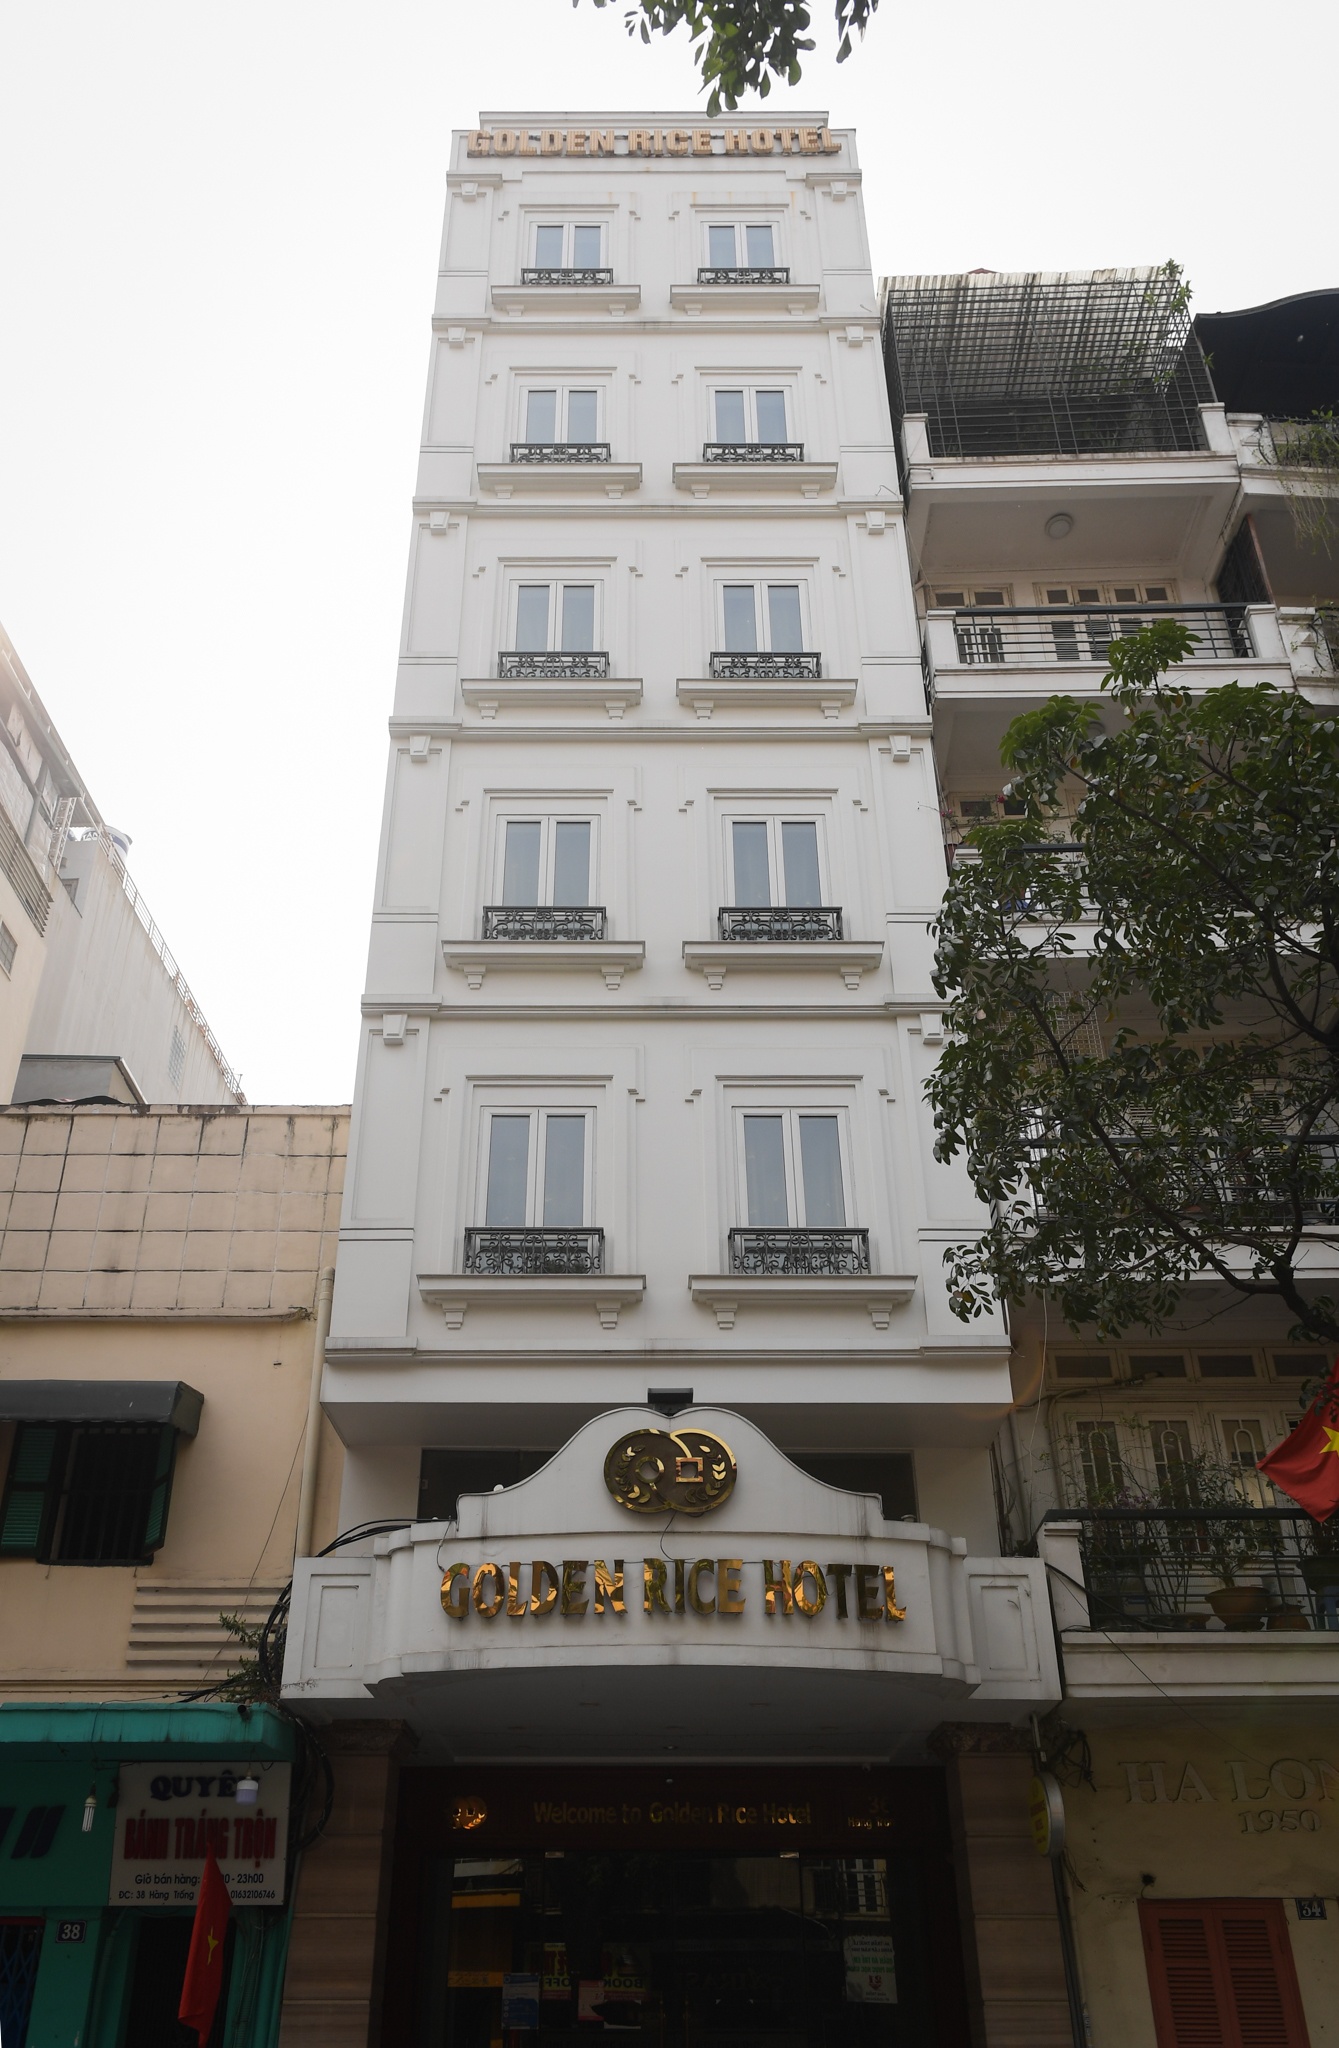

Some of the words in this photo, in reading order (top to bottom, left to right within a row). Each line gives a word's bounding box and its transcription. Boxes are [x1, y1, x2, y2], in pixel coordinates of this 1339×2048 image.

[467, 129, 615, 156] GOLDEN
[628, 129, 712, 156] RICE
[725, 127, 842, 155] HOTEL
[440, 1560, 626, 1618] GOLDEN
[643, 1559, 746, 1615] RICE
[763, 1560, 907, 1622] HOTEL
[151, 1769, 260, 1801] QUYÊ
[533, 1801, 616, 1824] Welcome
[622, 1803, 641, 1824] to
[649, 1801, 713, 1824] Golden
[717, 1802, 758, 1824] Rice
[762, 1801, 812, 1824] Hotel
[1238, 1809, 1321, 1834] 1950
[124, 1809, 169, 1860] BÁNH
[174, 1808, 229, 1860] TRÁNG
[233, 1808, 277, 1868] TRỘN
[135, 1873, 151, 1884] Giờ
[154, 1873, 172, 1884] bán
[174, 1873, 200, 1886] hàng:
[237, 1873, 264, 1884] 23h00
[119, 1891, 133, 1899] ĐC:
[136, 1891, 145, 1899] 38
[149, 1890, 169, 1901] Hàng
[174, 1889, 194, 1901] Trống
[1302, 1900, 1321, 1917] 34
[61, 1924, 80, 1940] 38
